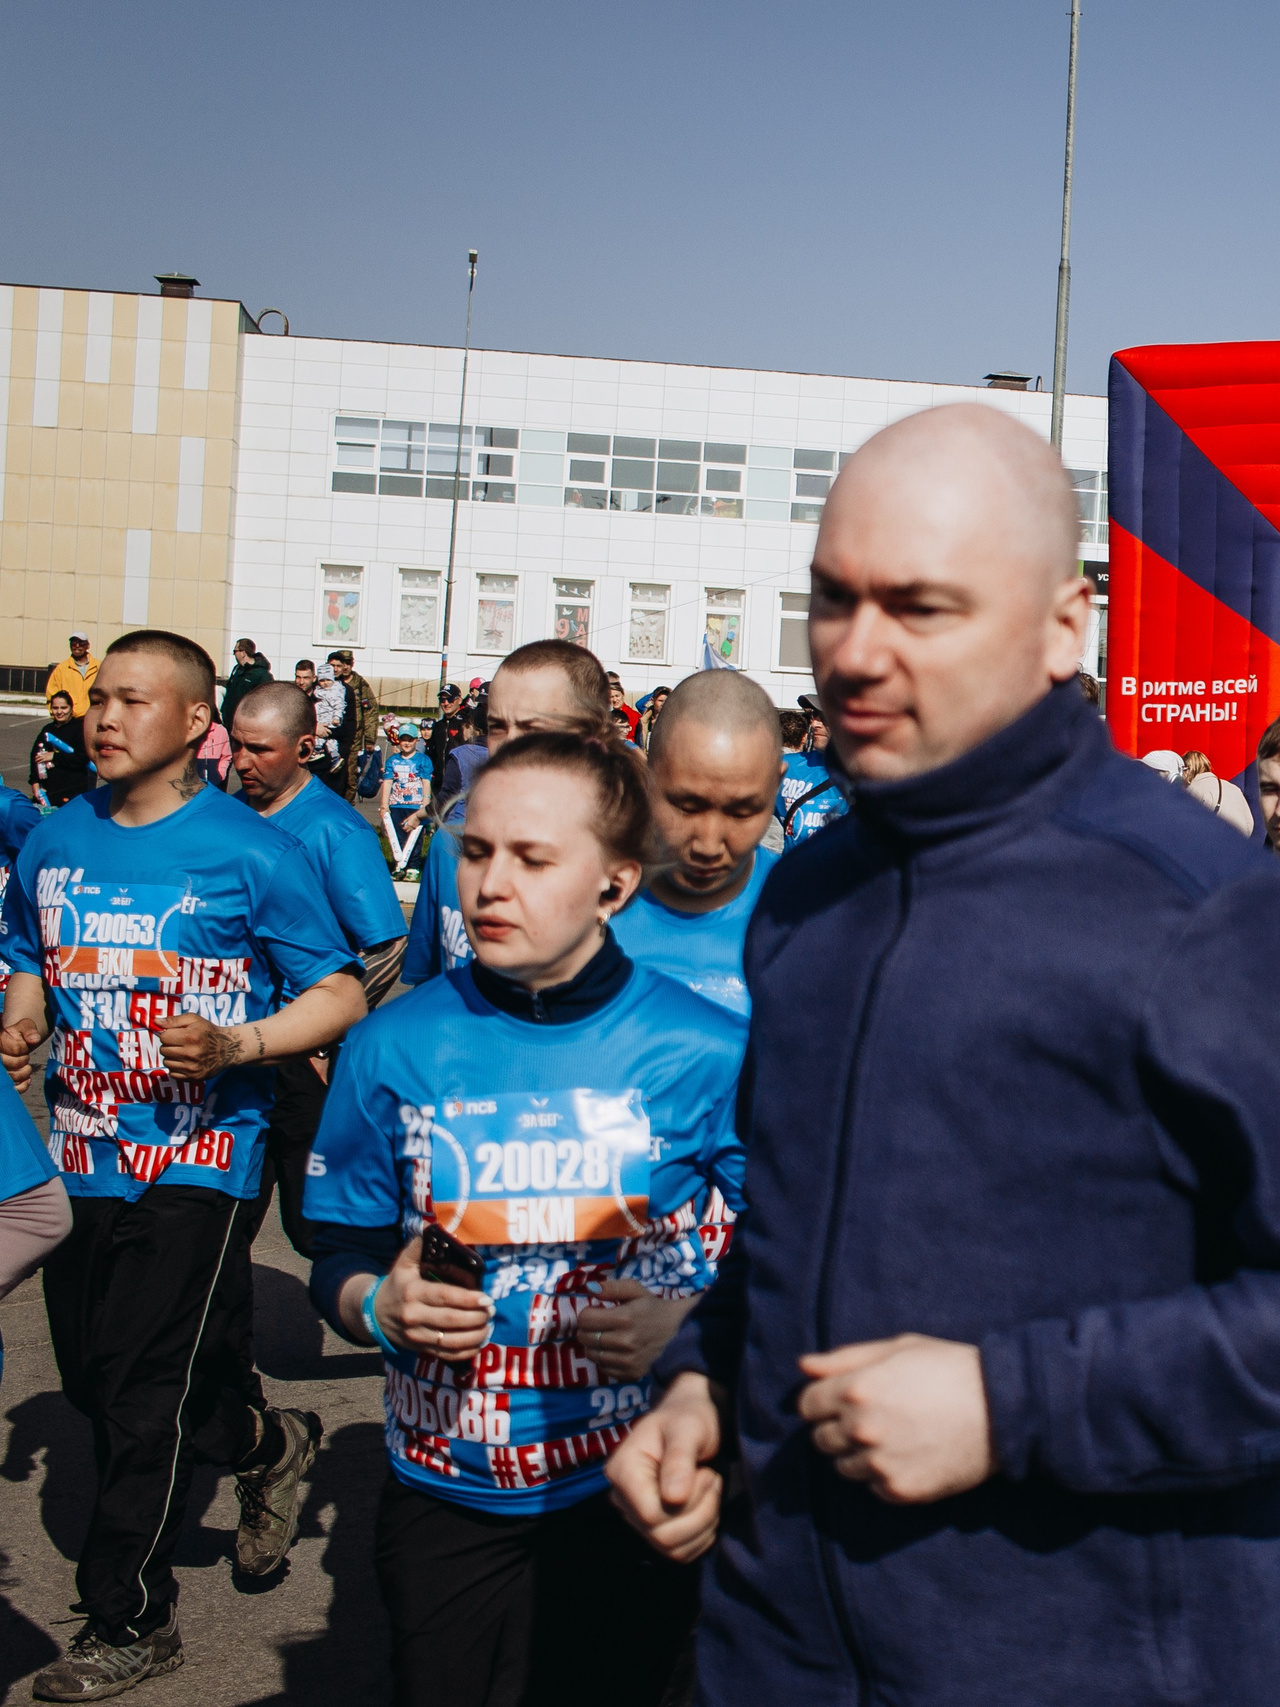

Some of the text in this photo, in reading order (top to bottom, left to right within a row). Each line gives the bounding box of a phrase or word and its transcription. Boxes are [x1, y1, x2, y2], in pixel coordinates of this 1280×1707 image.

[1121, 675, 1258, 698] В ритме всей
[1141, 702, 1237, 722] СТРАНЫ!
[82, 911, 156, 946] 20053
[97, 947, 135, 976] 5КМ
[474, 1138, 610, 1194] 20028
[507, 1196, 576, 1244] 5КМ
